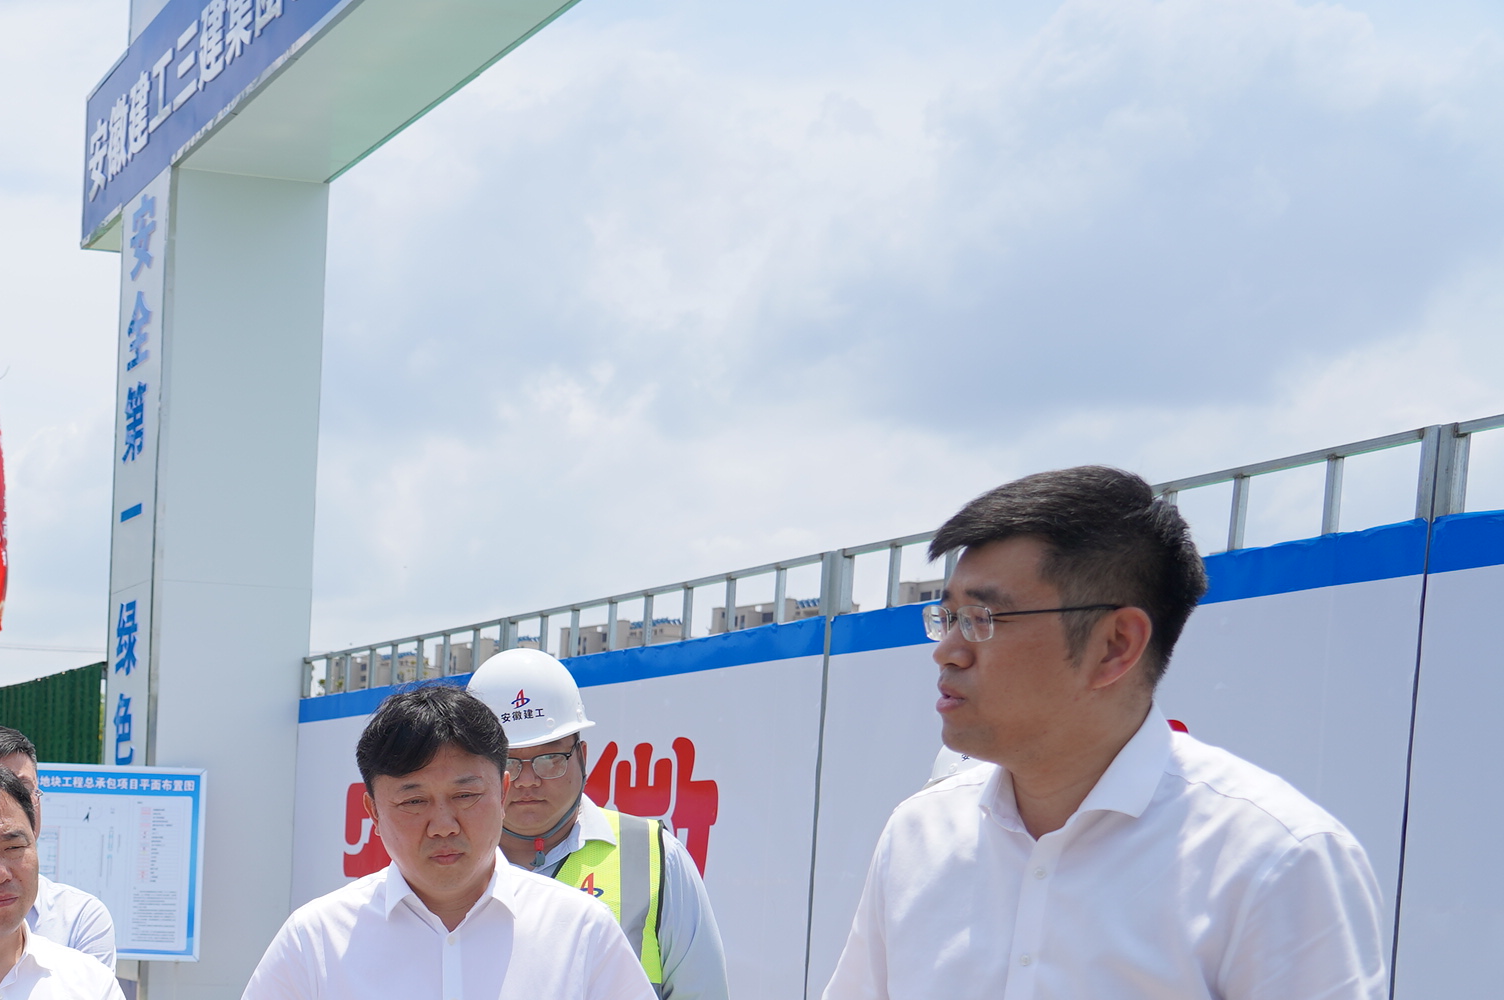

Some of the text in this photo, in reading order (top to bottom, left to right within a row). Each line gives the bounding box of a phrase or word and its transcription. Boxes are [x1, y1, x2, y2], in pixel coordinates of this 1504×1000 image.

[501, 708, 545, 723] 安徽建工
[37, 775, 195, 792] 地块工程总承包项目平面布置图
